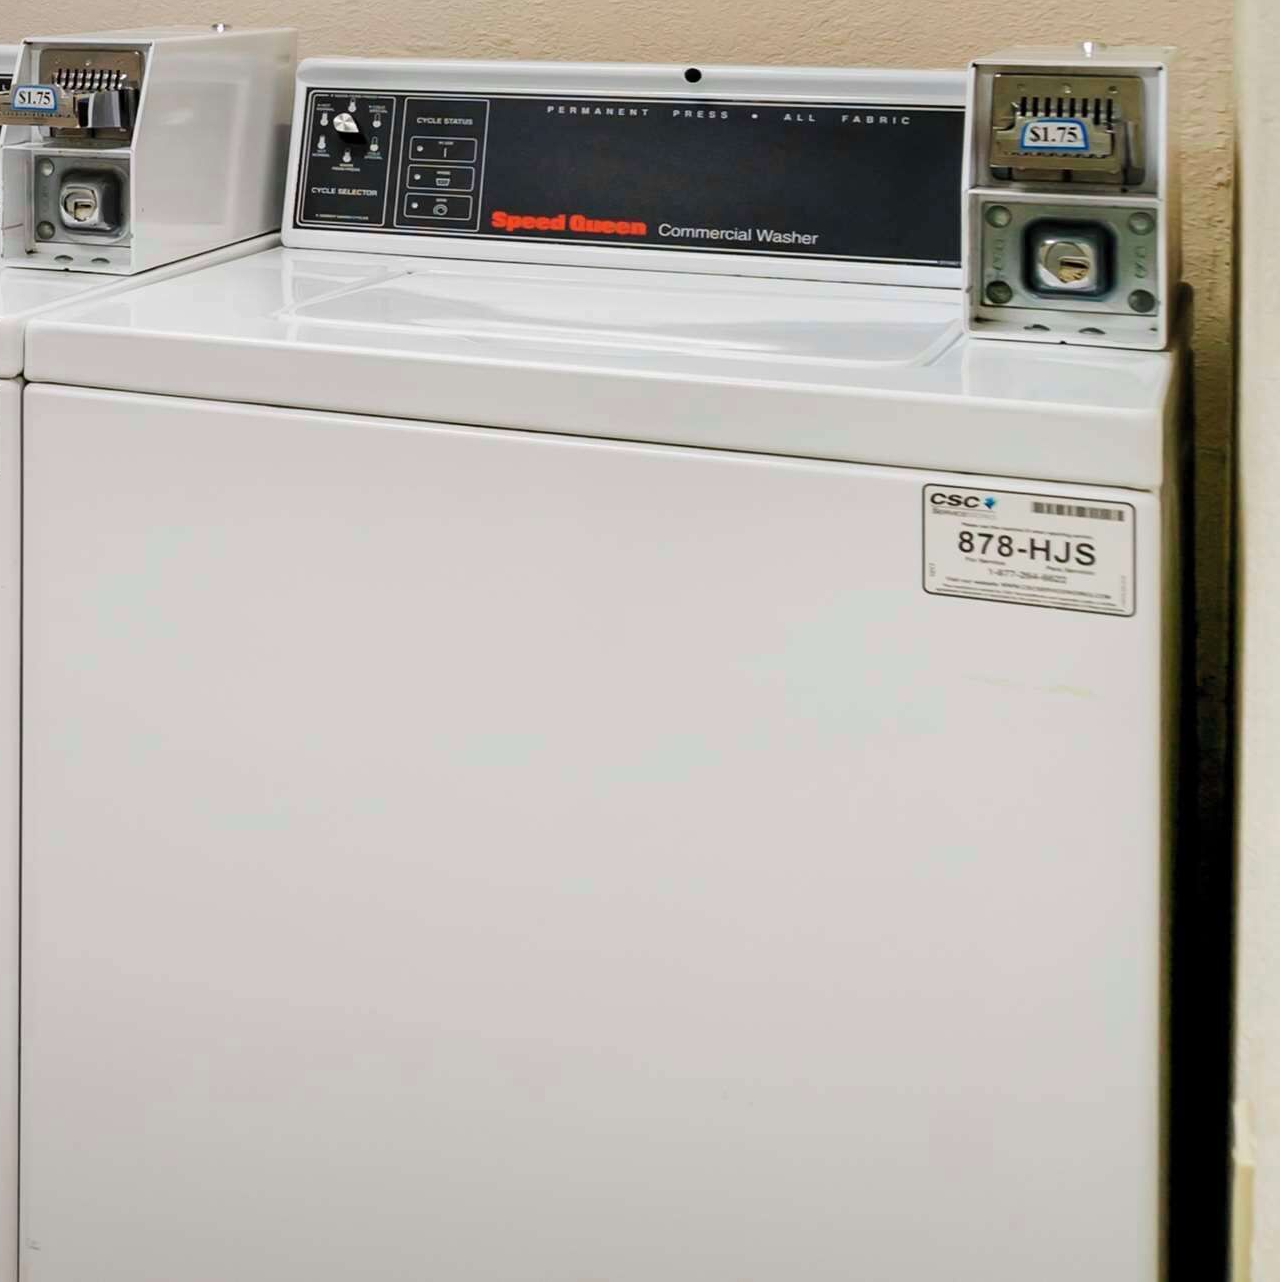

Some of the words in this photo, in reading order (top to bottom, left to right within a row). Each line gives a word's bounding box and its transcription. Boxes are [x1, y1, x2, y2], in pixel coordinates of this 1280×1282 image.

[18, 91, 52, 105] $1.75
[416, 117, 442, 125] CYCLE
[443, 118, 474, 126] STATUS
[547, 105, 649, 116] PERMANENT
[672, 109, 728, 119] PRESS
[783, 113, 816, 122] ALL
[841, 114, 910, 125] FABRIC
[1029, 126, 1079, 144] $1.75
[311, 186, 336, 194] CYCLE
[337, 188, 378, 196] SELECTOR
[491, 211, 566, 232] Speed
[568, 214, 647, 236] Queen
[658, 223, 752, 241] Commercial
[756, 229, 820, 245] Washer
[930, 492, 981, 508] CSC
[958, 530, 1095, 566] 878-HJS
